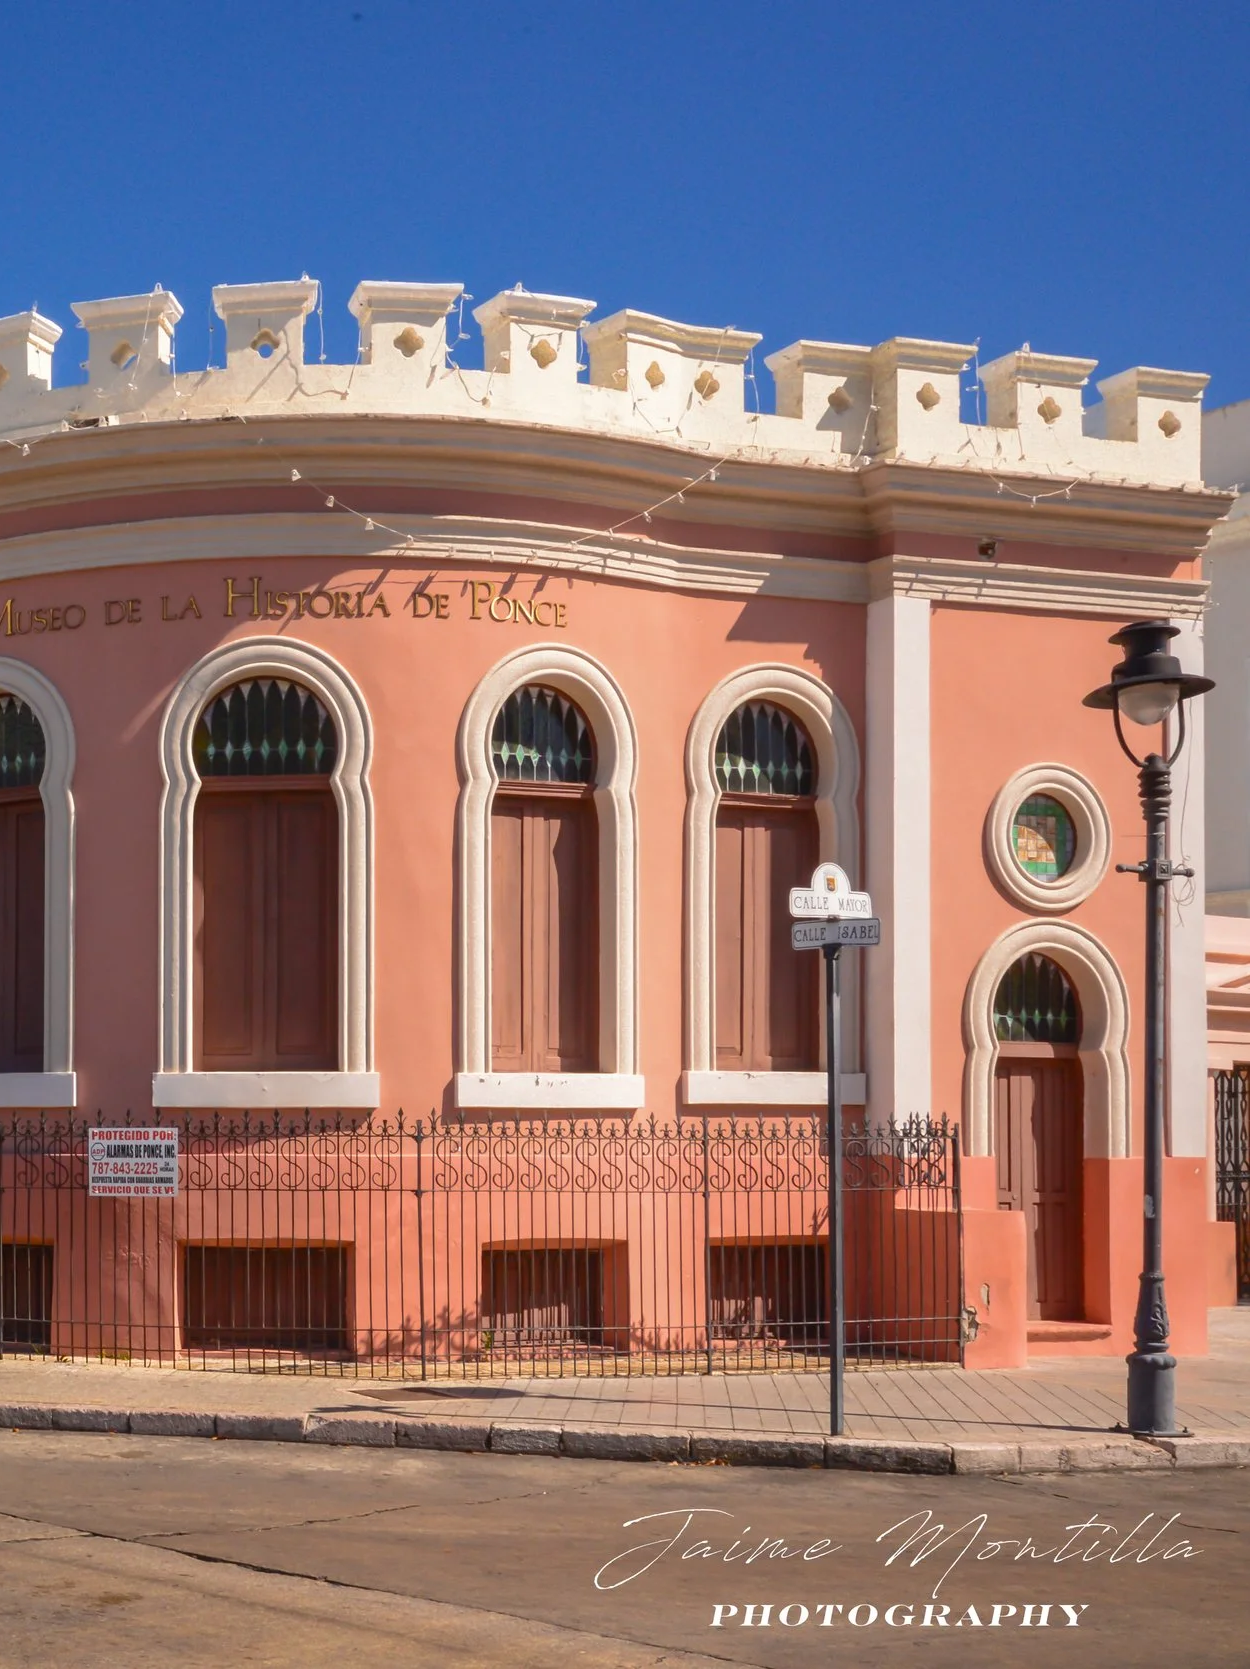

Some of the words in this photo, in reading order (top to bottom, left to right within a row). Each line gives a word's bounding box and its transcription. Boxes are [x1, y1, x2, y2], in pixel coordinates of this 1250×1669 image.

[793, 896, 829, 910] CALLE
[837, 898, 868, 913] MAYOR
[793, 927, 827, 942] CALLE
[837, 925, 879, 940] ISABEL
[91, 1130, 150, 1141] PROTEGIDO
[152, 1130, 177, 1141] POR:
[106, 1144, 134, 1159] ALARMAS
[134, 1144, 143, 1159] DE
[143, 1144, 163, 1160] PONCE,
[164, 1144, 177, 1159] INC.
[91, 1162, 159, 1175] 787-843-2225
[91, 1185, 132, 1195] SERVICIO
[133, 1185, 151, 1195] QUE
[152, 1185, 163, 1195] SE
[164, 1185, 175, 1195] VE
